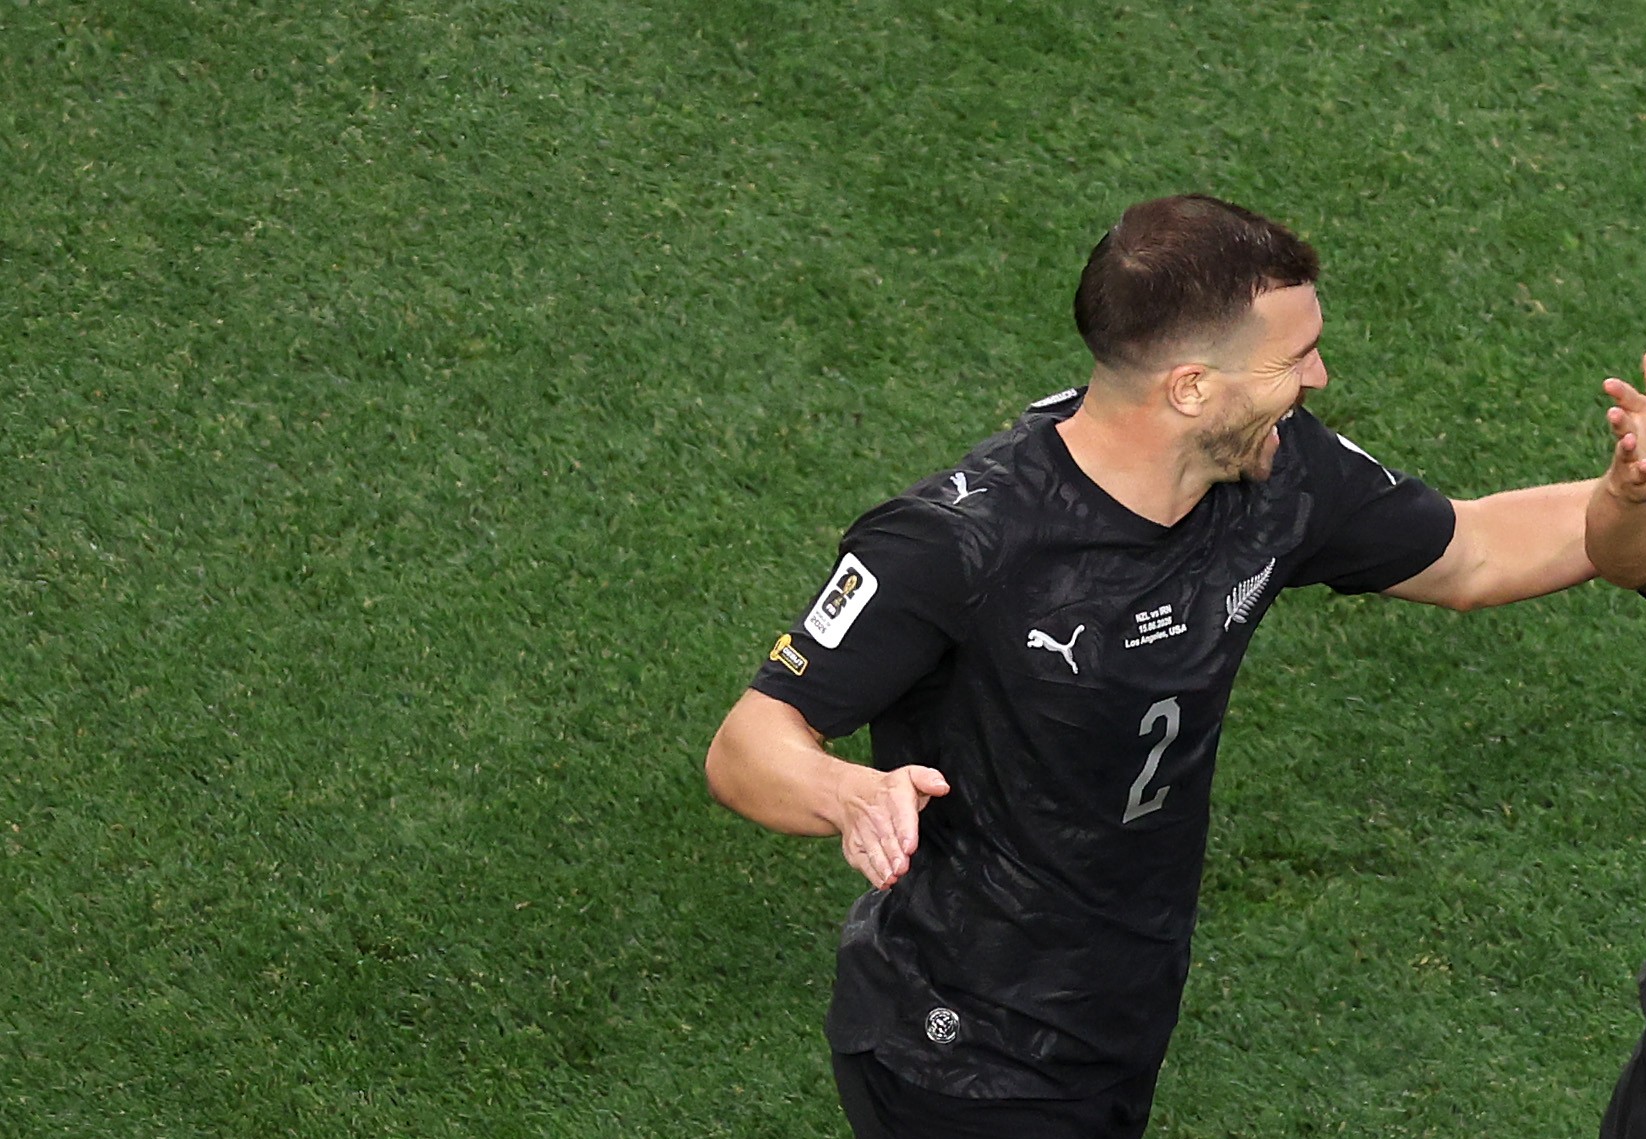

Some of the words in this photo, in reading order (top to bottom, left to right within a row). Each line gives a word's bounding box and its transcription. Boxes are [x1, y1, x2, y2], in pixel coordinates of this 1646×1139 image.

[1125, 638, 1140, 649] Los
[1168, 623, 1188, 636] USA
[1122, 695, 1181, 824] 2
